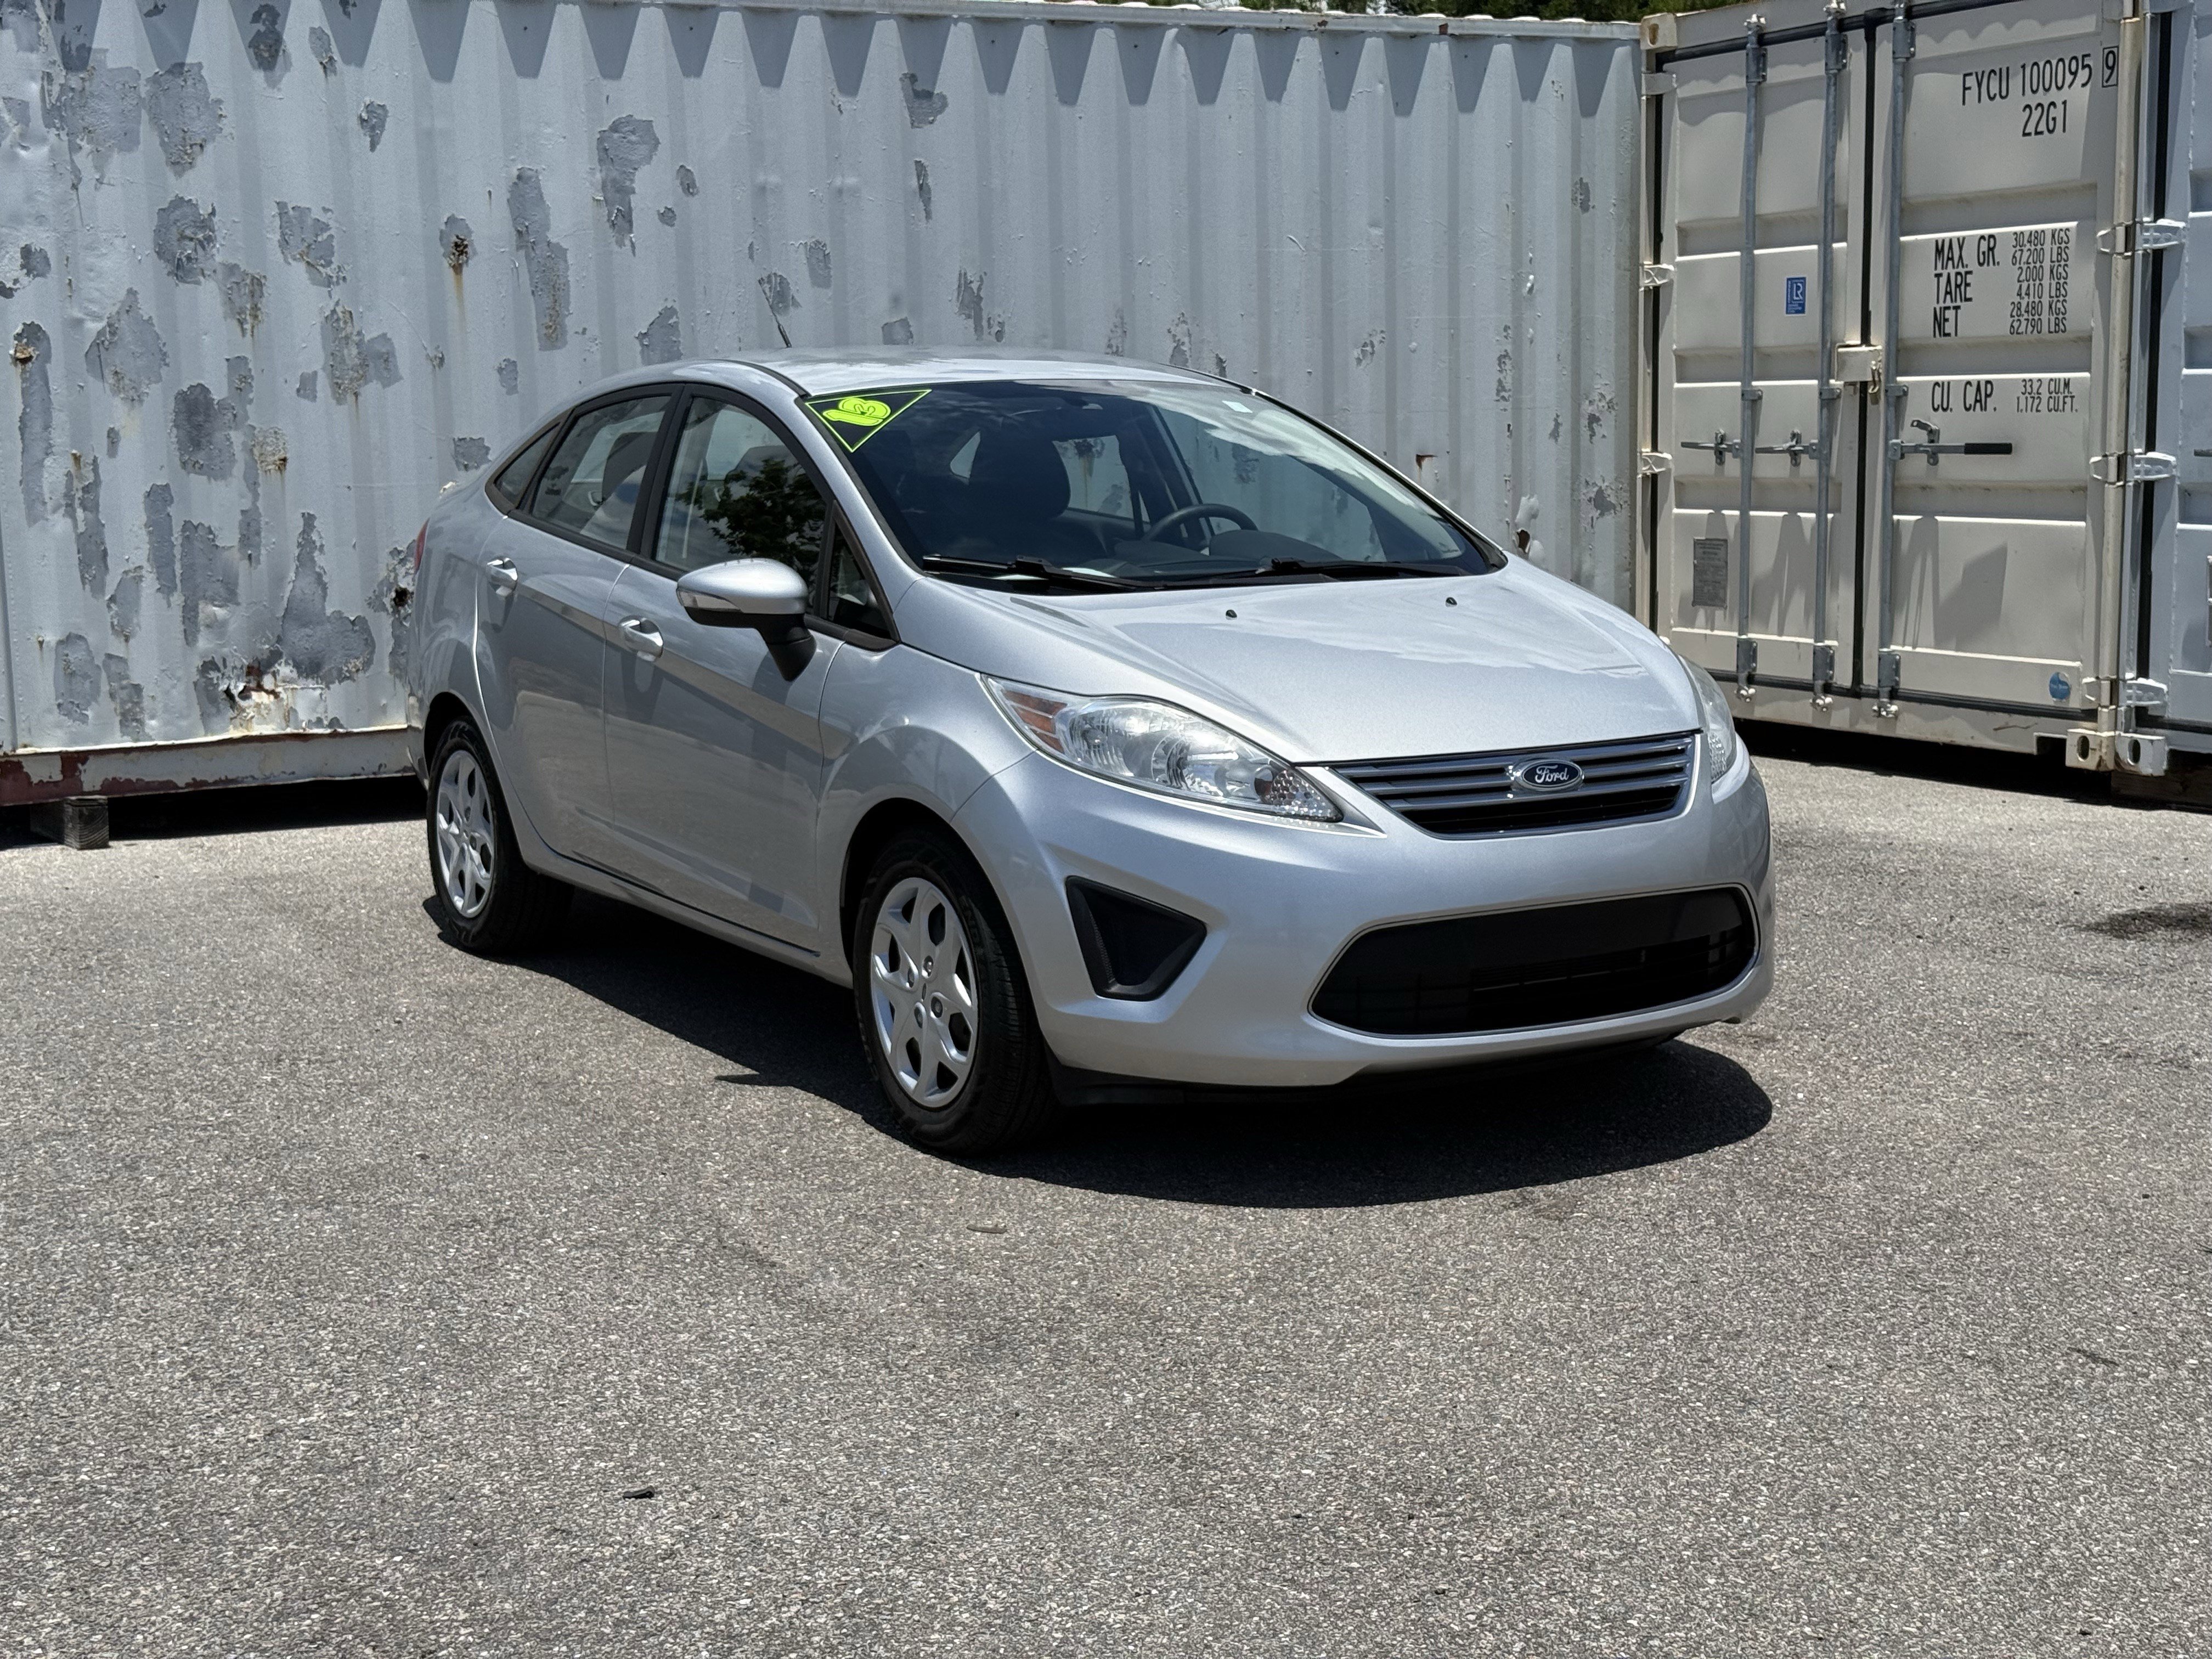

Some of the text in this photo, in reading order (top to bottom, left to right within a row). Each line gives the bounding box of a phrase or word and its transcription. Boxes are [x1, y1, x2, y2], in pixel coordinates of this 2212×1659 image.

[1962, 50, 2117, 106] FYCU 100095 9
[2022, 99, 2068, 137] 22G1
[1934, 228, 2070, 271] MAX. GR. 30.480 KGS
[2011, 246, 2070, 267] 67.200 LBS
[1934, 264, 2069, 304] TARE 2.000 KGS
[2016, 281, 2068, 301] 4.410 LBS
[1933, 299, 2068, 338] NET 28.480 KGS
[2009, 317, 2067, 336] 62.790 LBS
[1931, 381, 1953, 413] CU.
[1963, 380, 1997, 413] CAP.
[2021, 378, 2042, 396] 33.2
[2016, 396, 2042, 413] 1.172
[1535, 764, 1569, 783] Ford
